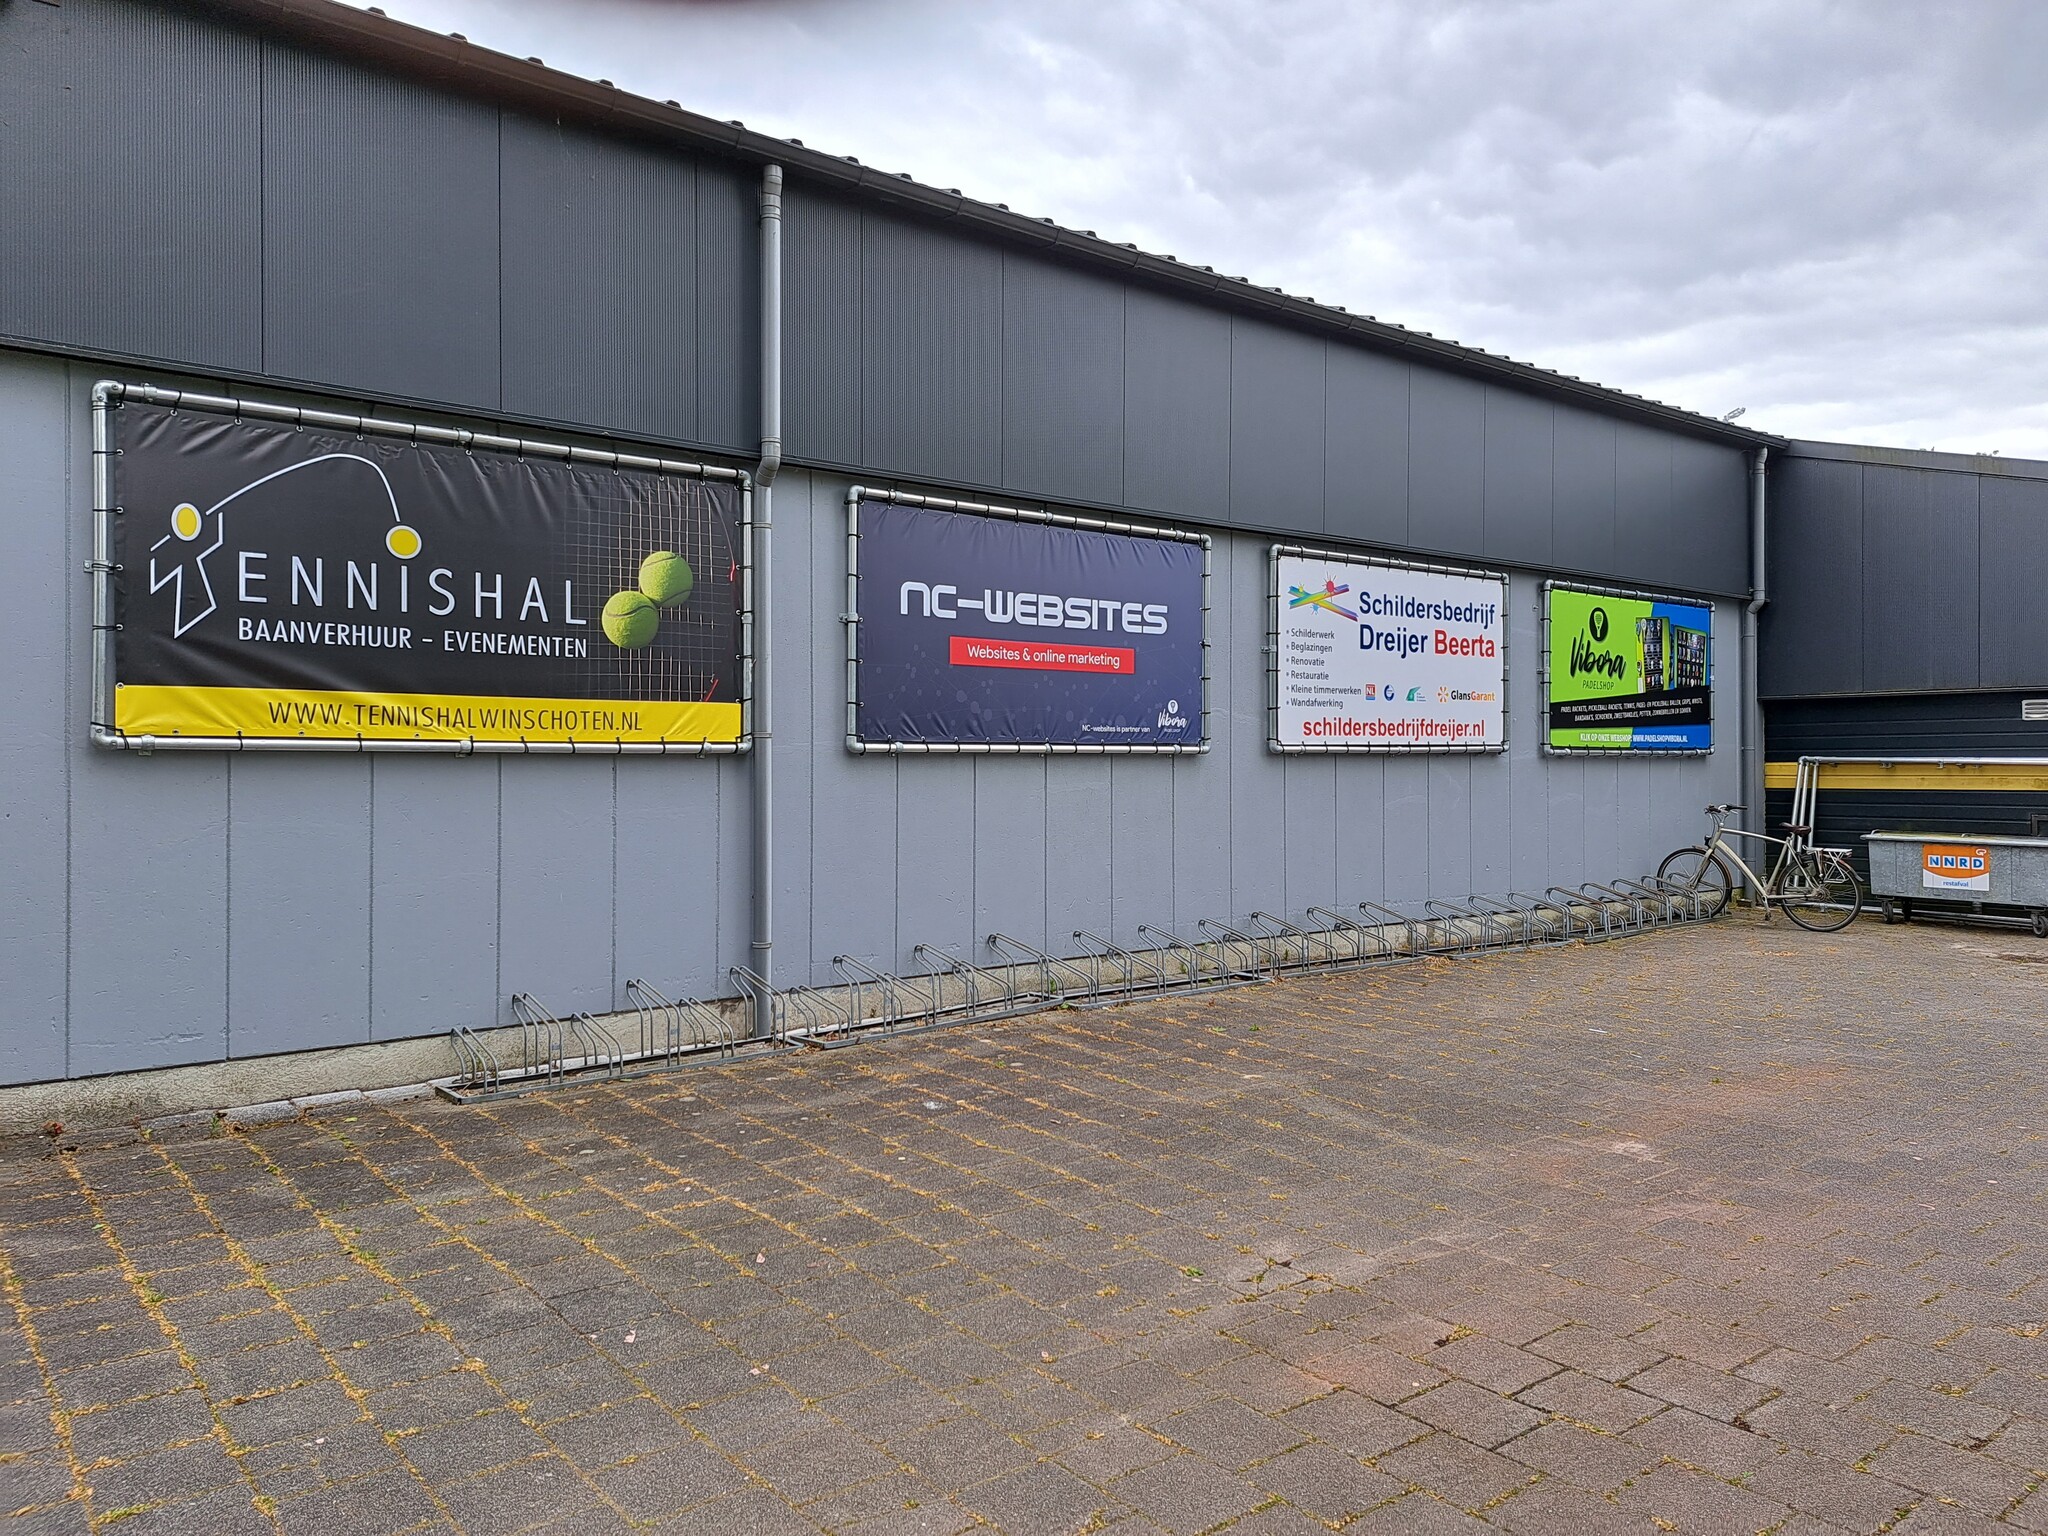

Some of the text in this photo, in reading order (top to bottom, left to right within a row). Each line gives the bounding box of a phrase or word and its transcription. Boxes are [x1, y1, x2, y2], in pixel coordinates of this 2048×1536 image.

[1359, 591, 1495, 630] Schildersbedrijf
[238, 618, 412, 649] BAANVERHUUR
[444, 630, 587, 658] EVENEMENTEN
[1291, 628, 1335, 639] Schilderwerk
[1360, 624, 1495, 659] Dreijer Beerta
[1291, 642, 1333, 654] Beglazingen
[1570, 628, 1626, 680] Vibora
[967, 643, 1120, 669] Websites & online marketing
[1291, 656, 1325, 666] Renovatie
[1291, 670, 1330, 680] Restauratie
[1291, 684, 1361, 695] Kleine timmerwerken
[1582, 680, 1614, 690] PADELSHOP
[1451, 690, 1495, 701] GlansGarant
[1291, 698, 1343, 709] Wandafwerking
[268, 701, 643, 731] WWW.TENNISHALWINSCHOTEN.NL
[1157, 708, 1187, 728] Vibora
[1082, 724, 1116, 732] NC-websites
[1121, 725, 1140, 733] partner
[1303, 717, 1485, 741] schildersbedrijfdreijer.nl
[1929, 856, 1983, 868] NNRD
